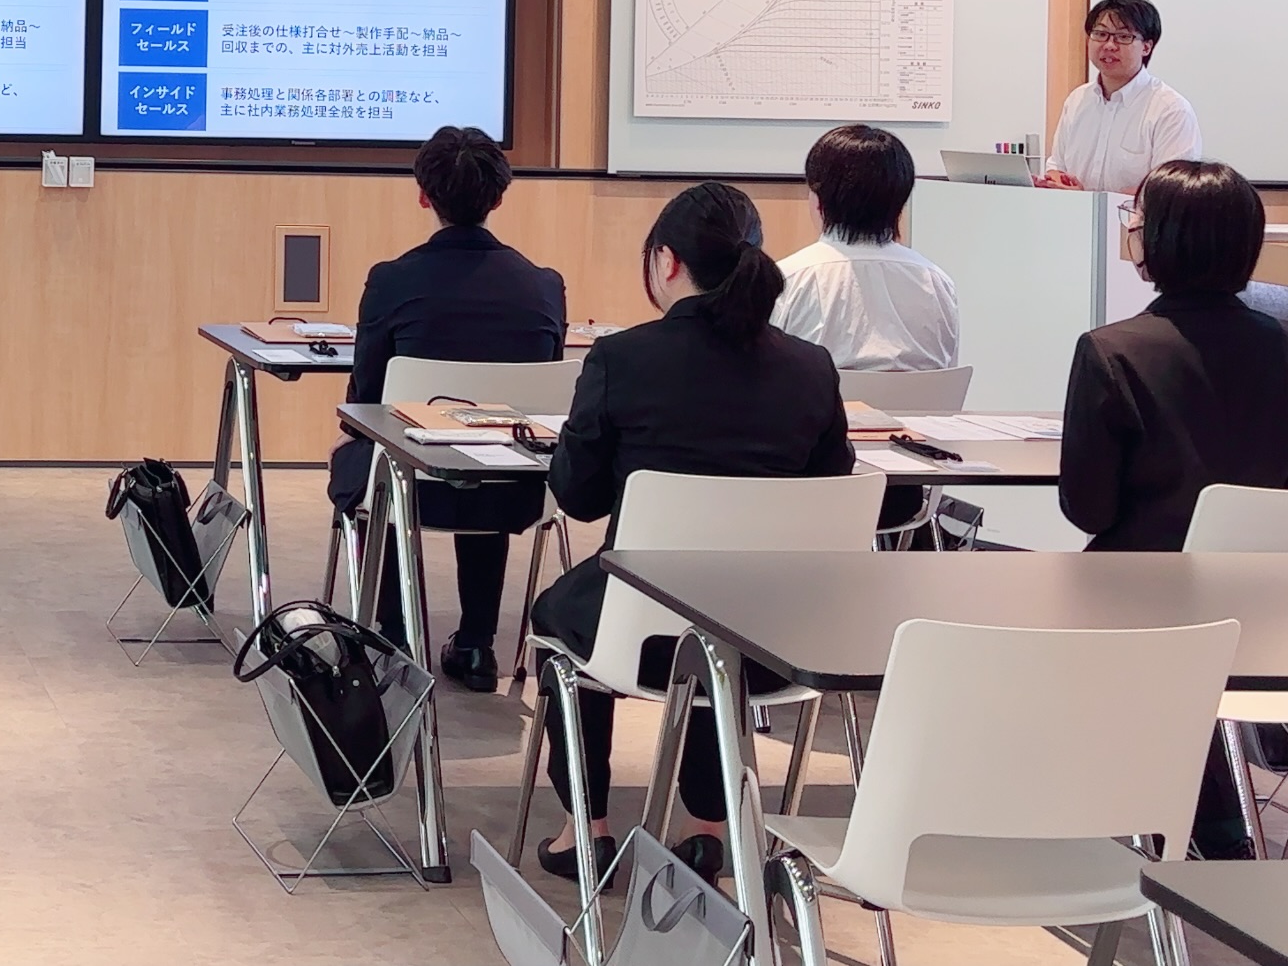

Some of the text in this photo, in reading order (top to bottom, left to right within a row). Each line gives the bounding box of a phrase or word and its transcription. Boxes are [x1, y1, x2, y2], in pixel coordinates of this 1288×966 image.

[131, 23, 196, 36] フィールド
[136, 39, 189, 52] セールス
[130, 85, 195, 99] インサイド
[135, 102, 188, 115] セールス
[912, 101, 941, 109] SINKO
[220, 104, 393, 120] 主に社内業務処理全般を担当
